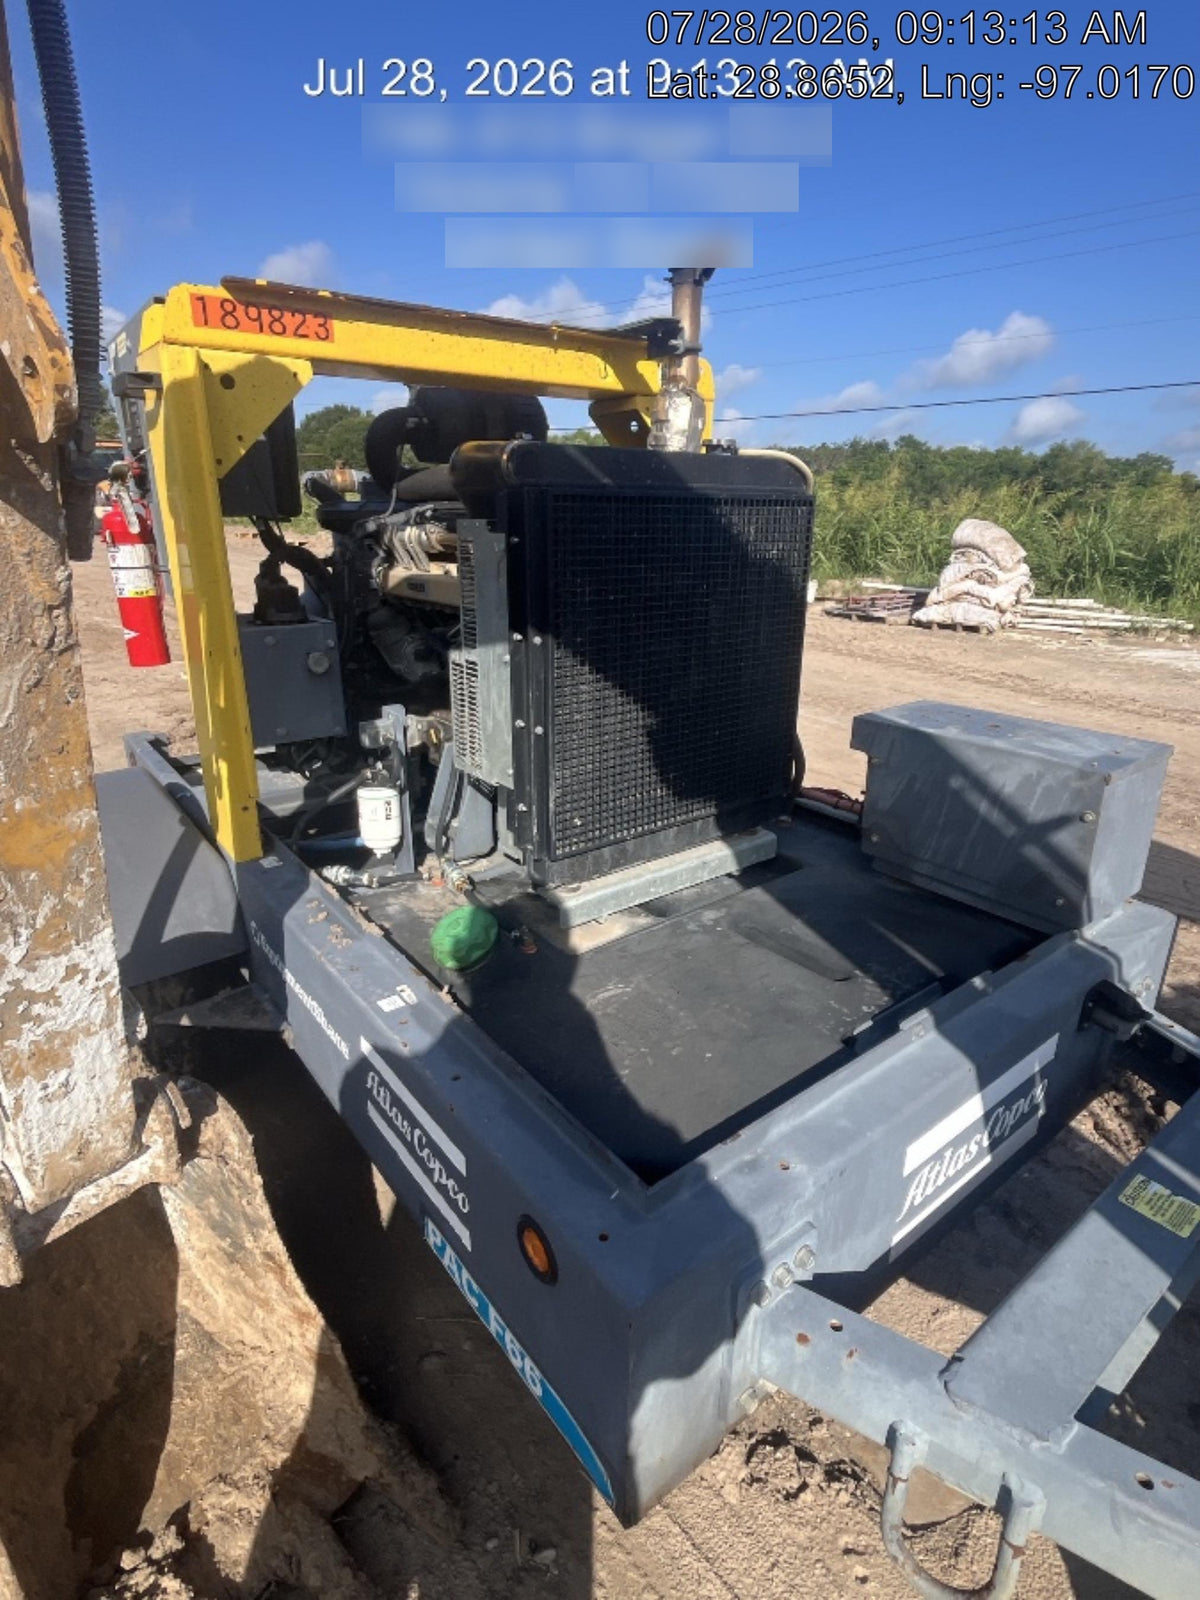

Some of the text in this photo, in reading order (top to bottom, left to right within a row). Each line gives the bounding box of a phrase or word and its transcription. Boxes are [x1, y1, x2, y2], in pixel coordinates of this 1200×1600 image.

[195, 295, 331, 342] 189823
[366, 1071, 470, 1214] Atlas Copco
[895, 1078, 1049, 1223] Atlas Copco
[426, 1219, 543, 1397] PAC F66
